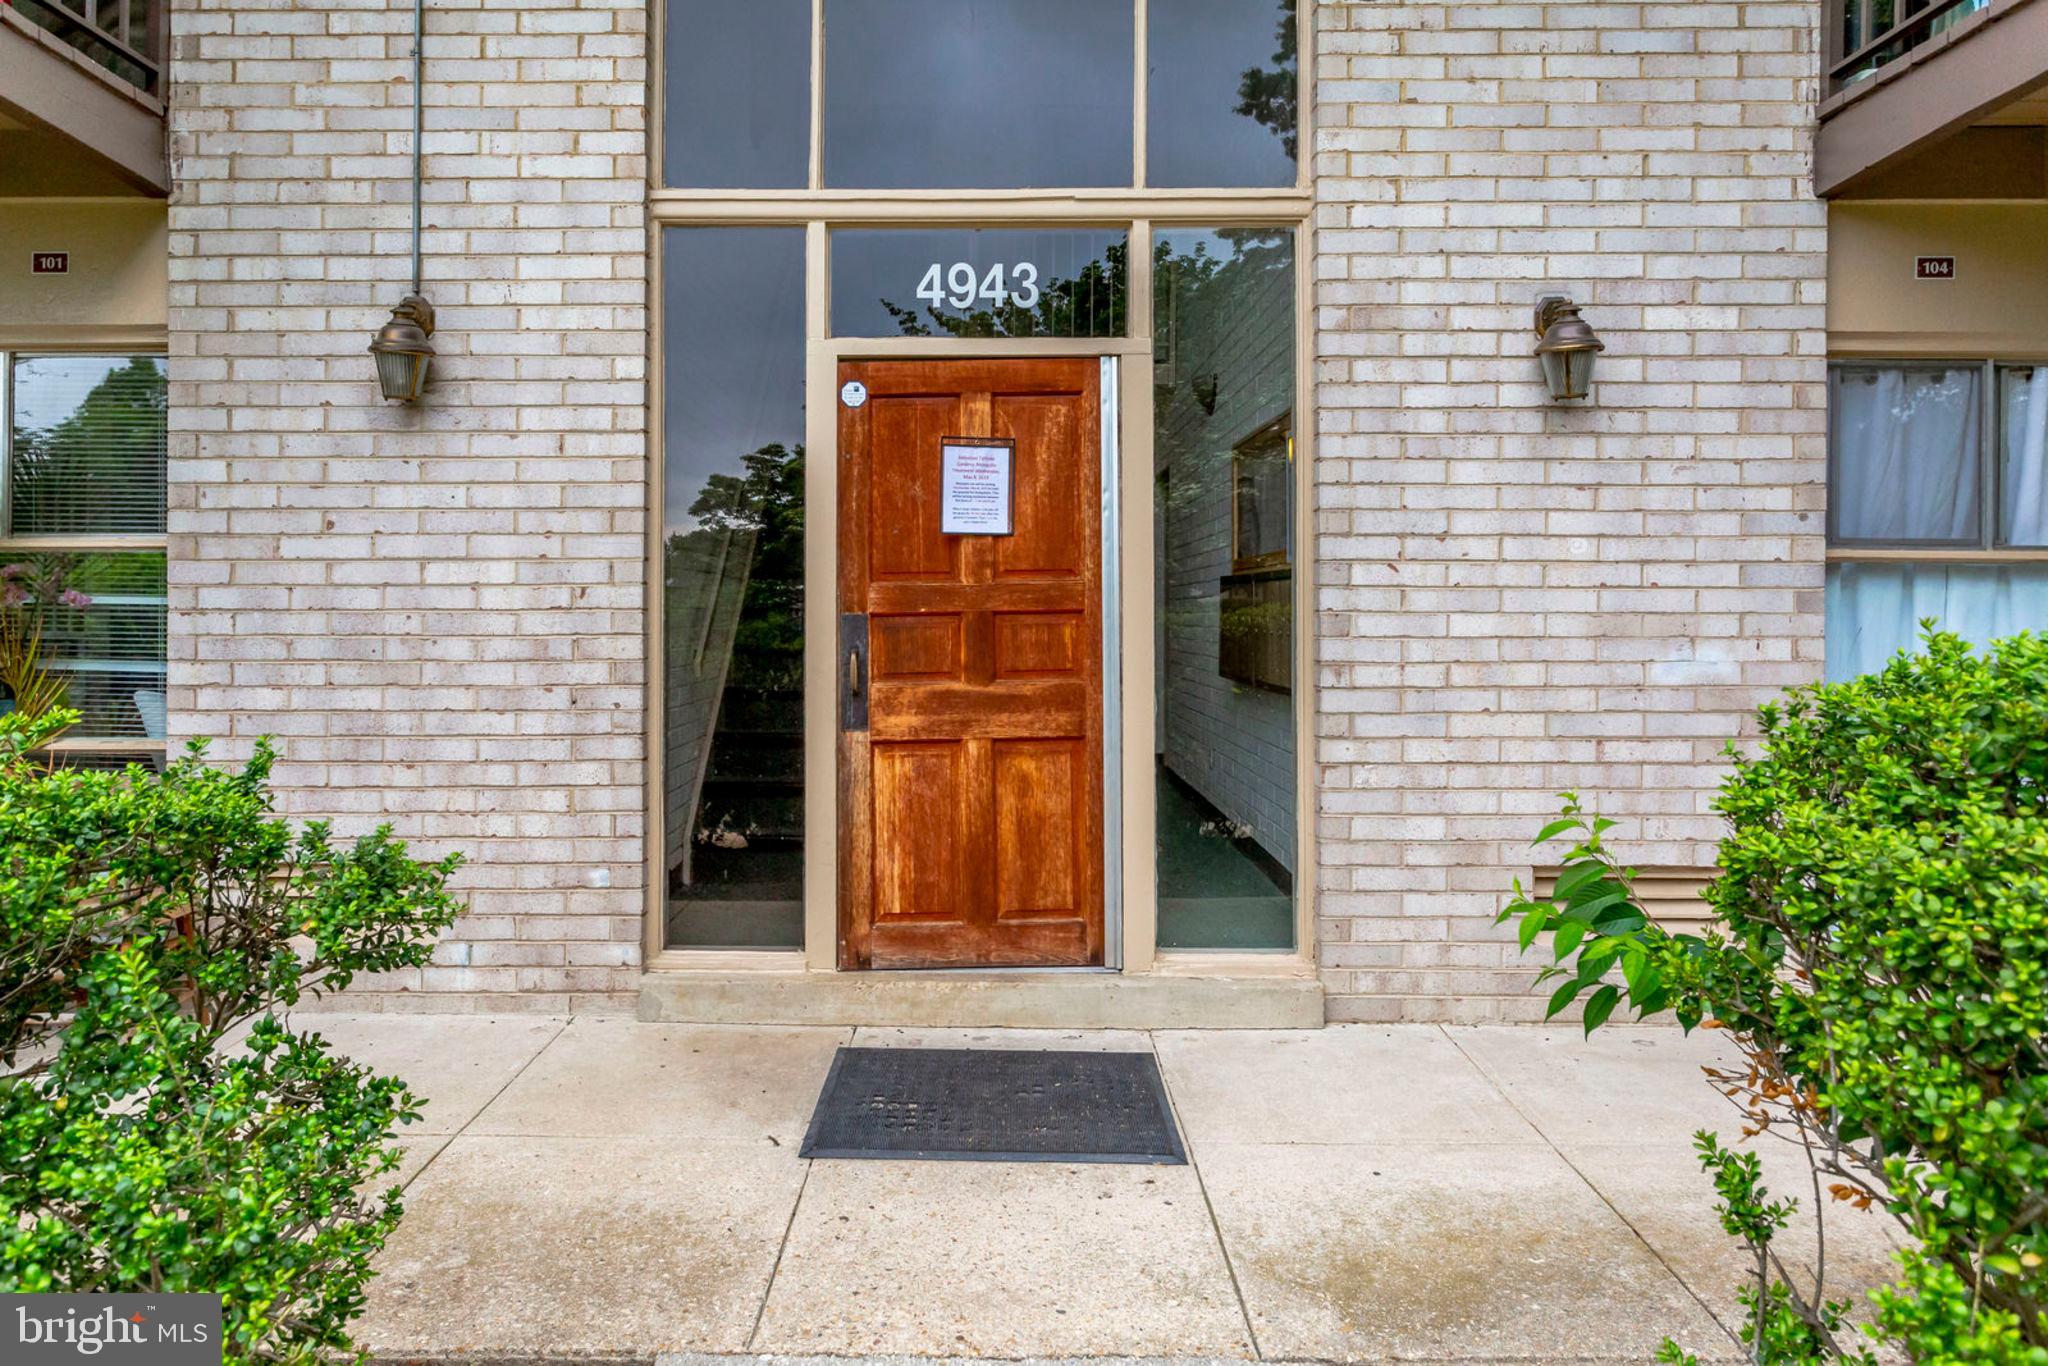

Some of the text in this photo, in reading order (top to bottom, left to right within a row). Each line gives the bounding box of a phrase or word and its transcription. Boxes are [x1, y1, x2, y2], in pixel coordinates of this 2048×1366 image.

[39, 256, 62, 269] 101
[1922, 261, 1949, 274] 104
[916, 262, 1039, 309] 4943
